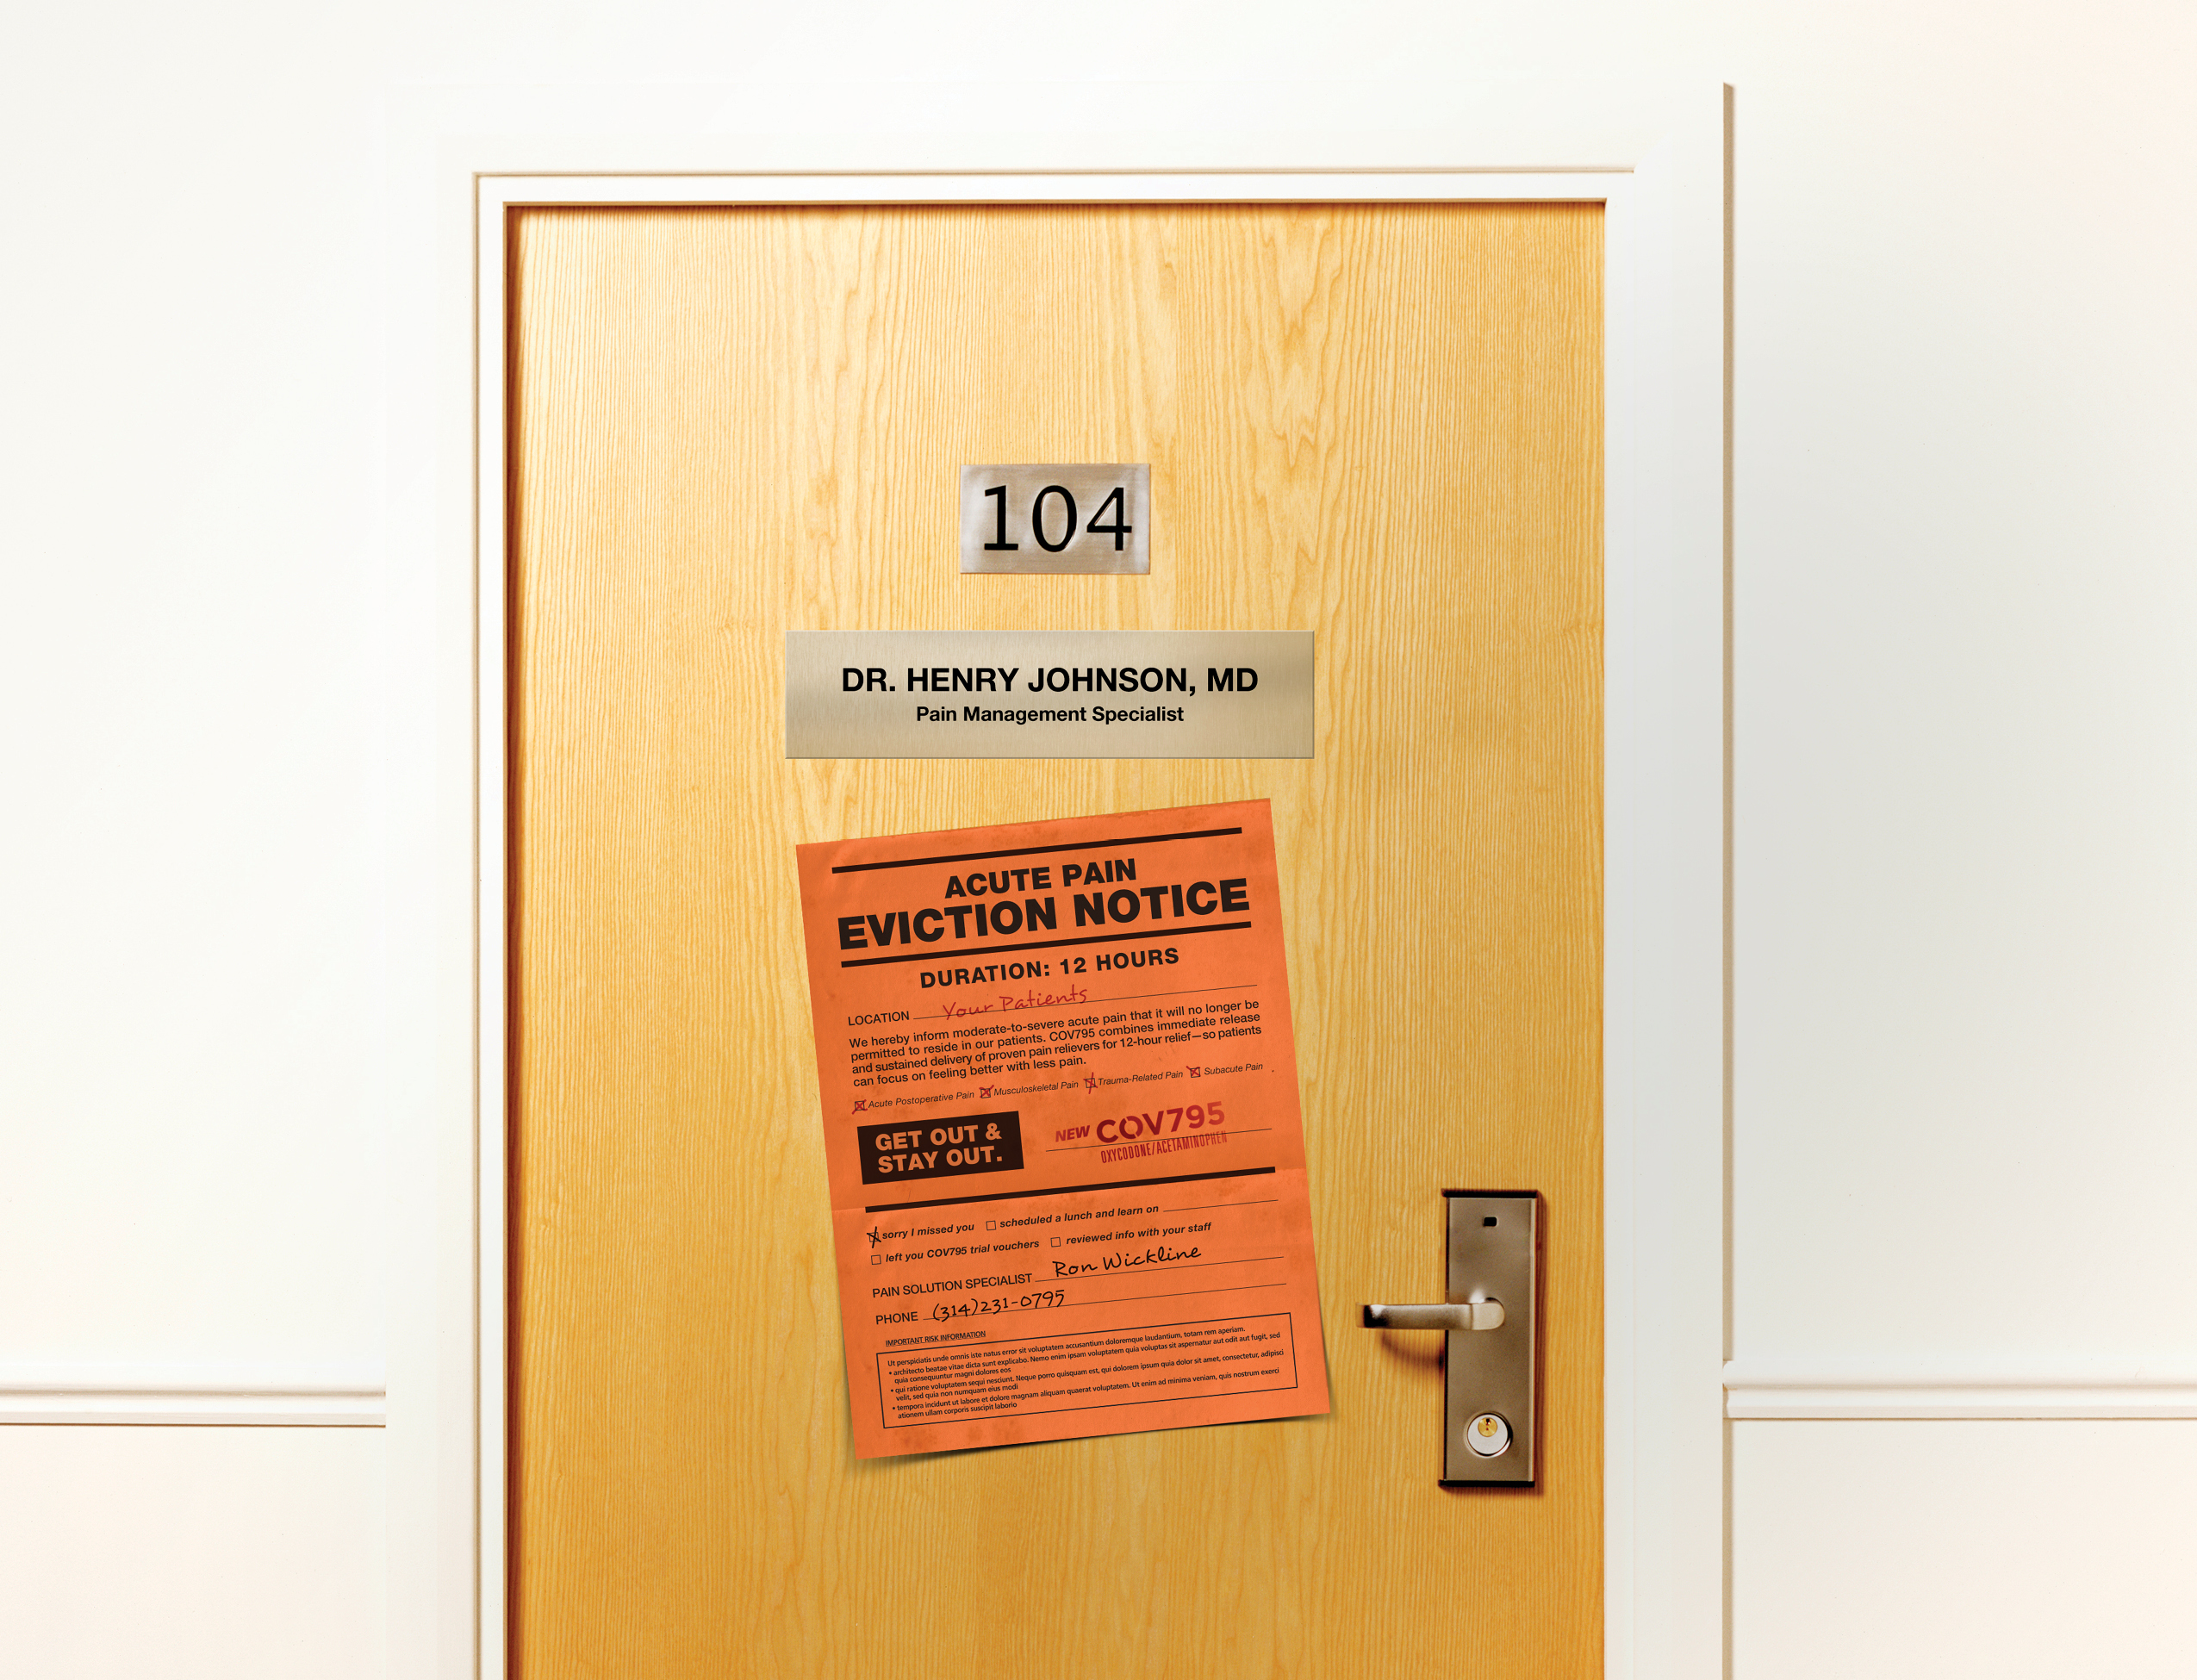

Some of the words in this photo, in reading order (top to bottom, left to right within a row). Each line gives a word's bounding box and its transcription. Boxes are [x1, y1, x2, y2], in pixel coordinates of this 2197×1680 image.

[984, 484, 1133, 553] 104
[843, 668, 896, 692] DR.
[907, 668, 1019, 692] HENRY
[1028, 667, 1196, 697] JOHNSON,
[1207, 668, 1259, 692] MD
[917, 706, 957, 722] Pain
[963, 706, 1087, 725] Management
[1092, 706, 1185, 725] Specialist
[944, 866, 1052, 899] ACUTE
[1061, 857, 1136, 887] PAIN
[837, 896, 1057, 950] EVICTION
[1073, 877, 1250, 927] NOTICE
[919, 961, 1050, 989] DURATION:
[1060, 956, 1087, 974] 12
[1096, 947, 1179, 972] HOURS
[942, 1001, 993, 1021] Your
[999, 984, 1087, 1012] Patients
[848, 1011, 910, 1026] LOCATION
[849, 1037, 868, 1048] We
[871, 1034, 910, 1046] hereby
[913, 1031, 949, 1042] inform
[952, 1020, 1065, 1038] moderate-to-severe
[1067, 1015, 1099, 1027] acute
[1103, 1011, 1127, 1026] pain
[1130, 1010, 1153, 1021] that
[1155, 1008, 1163, 1018] it
[1166, 1005, 1185, 1017] will
[1188, 1006, 1203, 1015] no
[1205, 1002, 1242, 1014] longer
[1244, 999, 1260, 1010] be
[850, 1046, 906, 1064] permitted
[908, 1046, 920, 1055] to
[924, 1042, 958, 1055] reside
[962, 1040, 972, 1050] in
[974, 1040, 994, 1049] our
[997, 1034, 1046, 1049] patients.
[1049, 1028, 1096, 1042] COV795
[1098, 1024, 1155, 1037] combines
[1157, 1017, 1217, 1031] immediate
[1219, 1013, 1260, 1025] release
[852, 1062, 873, 1074] and
[874, 1057, 928, 1072] sustained
[930, 1055, 973, 1067] delivery
[974, 1051, 986, 1062] of
[988, 1049, 1026, 1063] proven
[1029, 1045, 1052, 1059] pain
[1054, 1042, 1100, 1055] relievers
[1102, 1039, 1117, 1049] for
[1119, 1036, 1162, 1048] 12-hour
[1217, 1025, 1262, 1041] patients
[853, 1077, 874, 1087] can
[876, 1074, 909, 1085] focus
[912, 1073, 926, 1081] on
[929, 1067, 967, 1080] feeling
[969, 1064, 1004, 1075] better
[1006, 1060, 1030, 1072] with
[1033, 1059, 1056, 1069] less
[1059, 1055, 1086, 1069] pain.
[1098, 1072, 1164, 1086] Trauma-Related
[1165, 1070, 1184, 1080] Pain
[1204, 1065, 1243, 1075] Subacute
[1245, 1062, 1263, 1072] Pain
[868, 1099, 893, 1109] Acute
[895, 1093, 954, 1106] Postoperative
[955, 1092, 974, 1100] Pain
[993, 1082, 1059, 1096] Musculoskeletal
[1061, 1080, 1079, 1090] Pain
[1055, 1124, 1091, 1142] NEW
[1096, 1101, 1225, 1144] COV795
[875, 1129, 923, 1151] GET
[930, 1124, 979, 1146] OUT
[985, 1123, 1002, 1141] &
[1100, 1130, 1228, 1164] OXYCODONE/ACETAMINOPHEN
[878, 1151, 938, 1173] STAY
[946, 1145, 1003, 1167] OUT.
[999, 1214, 1053, 1229] scheduled
[1064, 1210, 1092, 1222] lunch
[1095, 1208, 1115, 1219] and
[1117, 1207, 1143, 1216] learn
[1146, 1205, 1159, 1214] on
[882, 1230, 908, 1240] sorry
[917, 1223, 954, 1236] missed
[955, 1224, 974, 1235] you
[1066, 1231, 1113, 1245] reviewed
[1115, 1229, 1135, 1240] info
[1137, 1227, 1160, 1237] with
[1162, 1226, 1186, 1237] your
[1188, 1222, 1212, 1233] staff
[885, 1253, 903, 1263] left
[905, 1252, 924, 1263] you
[926, 1246, 968, 1259] COV795
[969, 1243, 991, 1254] trial
[993, 1241, 1040, 1252] vouchers
[1053, 1260, 1098, 1278] Ron
[1103, 1246, 1202, 1271] Wickline
[872, 1285, 900, 1298] PAIN
[902, 1279, 962, 1296] SOLUTION
[965, 1272, 1033, 1290] SPECIALIST
[875, 1311, 918, 1325] PHONE
[931, 1289, 1065, 1322] (314)231-0795
[885, 1336, 924, 1347] IMPORTANT
[924, 1335, 939, 1343] RISK
[940, 1330, 986, 1342] INFORMATION
[896, 1356, 932, 1367] perspiciatis
[932, 1354, 949, 1363] unde
[1027, 1344, 1064, 1353] voluptatem
[1065, 1341, 1105, 1349] accusantium
[1105, 1336, 1144, 1346] doloremque
[1144, 1333, 1183, 1341] laudantium,
[1217, 1327, 1246, 1335] aperiam.
[893, 1367, 924, 1376] architecto
[997, 1357, 1030, 1366] explicabo.
[1067, 1352, 1086, 1360] ipsam
[1087, 1348, 1124, 1357] voluptatem
[1124, 1346, 1140, 1354] quia
[1177, 1340, 1212, 1349] aspernatur
[1250, 1334, 1268, 1342] fugit,
[909, 1373, 953, 1383] consequuntur
[943, 1407, 970, 1416] corporis
[970, 1403, 994, 1412] suscipit
